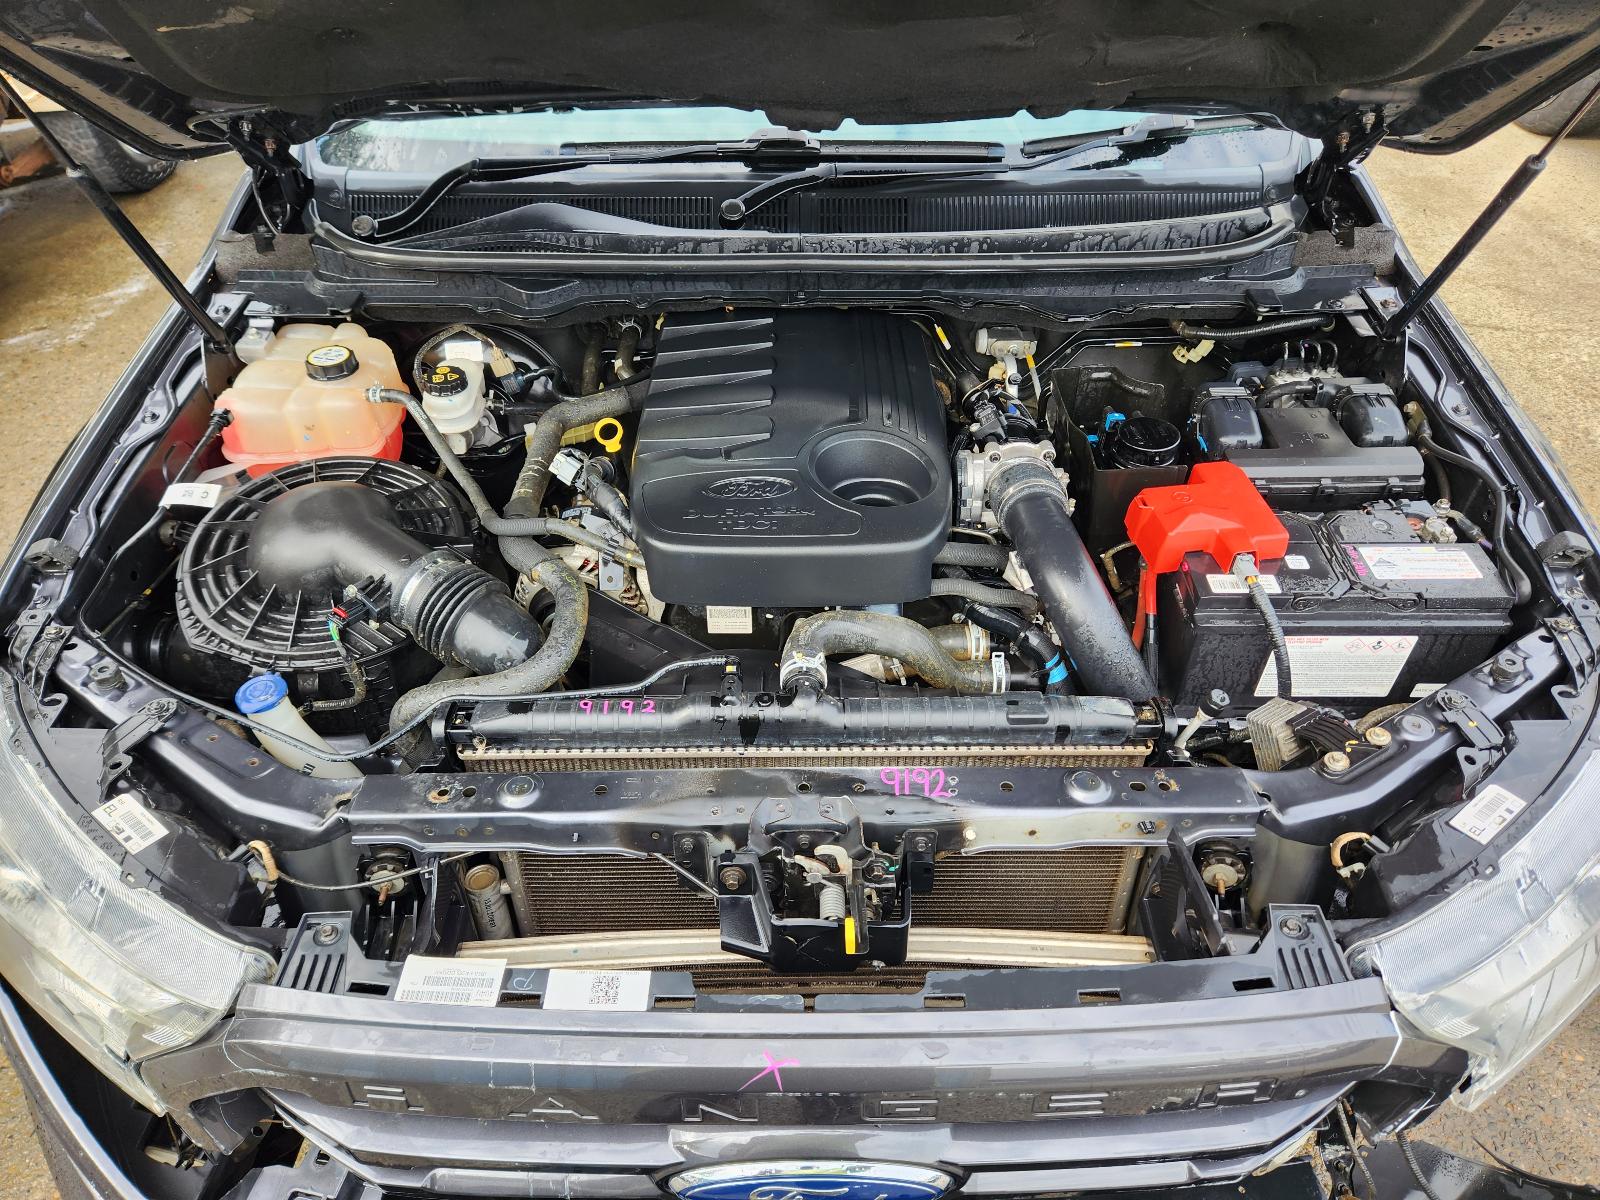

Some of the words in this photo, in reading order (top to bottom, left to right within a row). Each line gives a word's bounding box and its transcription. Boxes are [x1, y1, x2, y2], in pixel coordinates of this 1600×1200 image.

[720, 480, 779, 498] Ford
[579, 699, 656, 717] 9192
[880, 767, 952, 798] 9192
[344, 1078, 1279, 1123] RANGER
